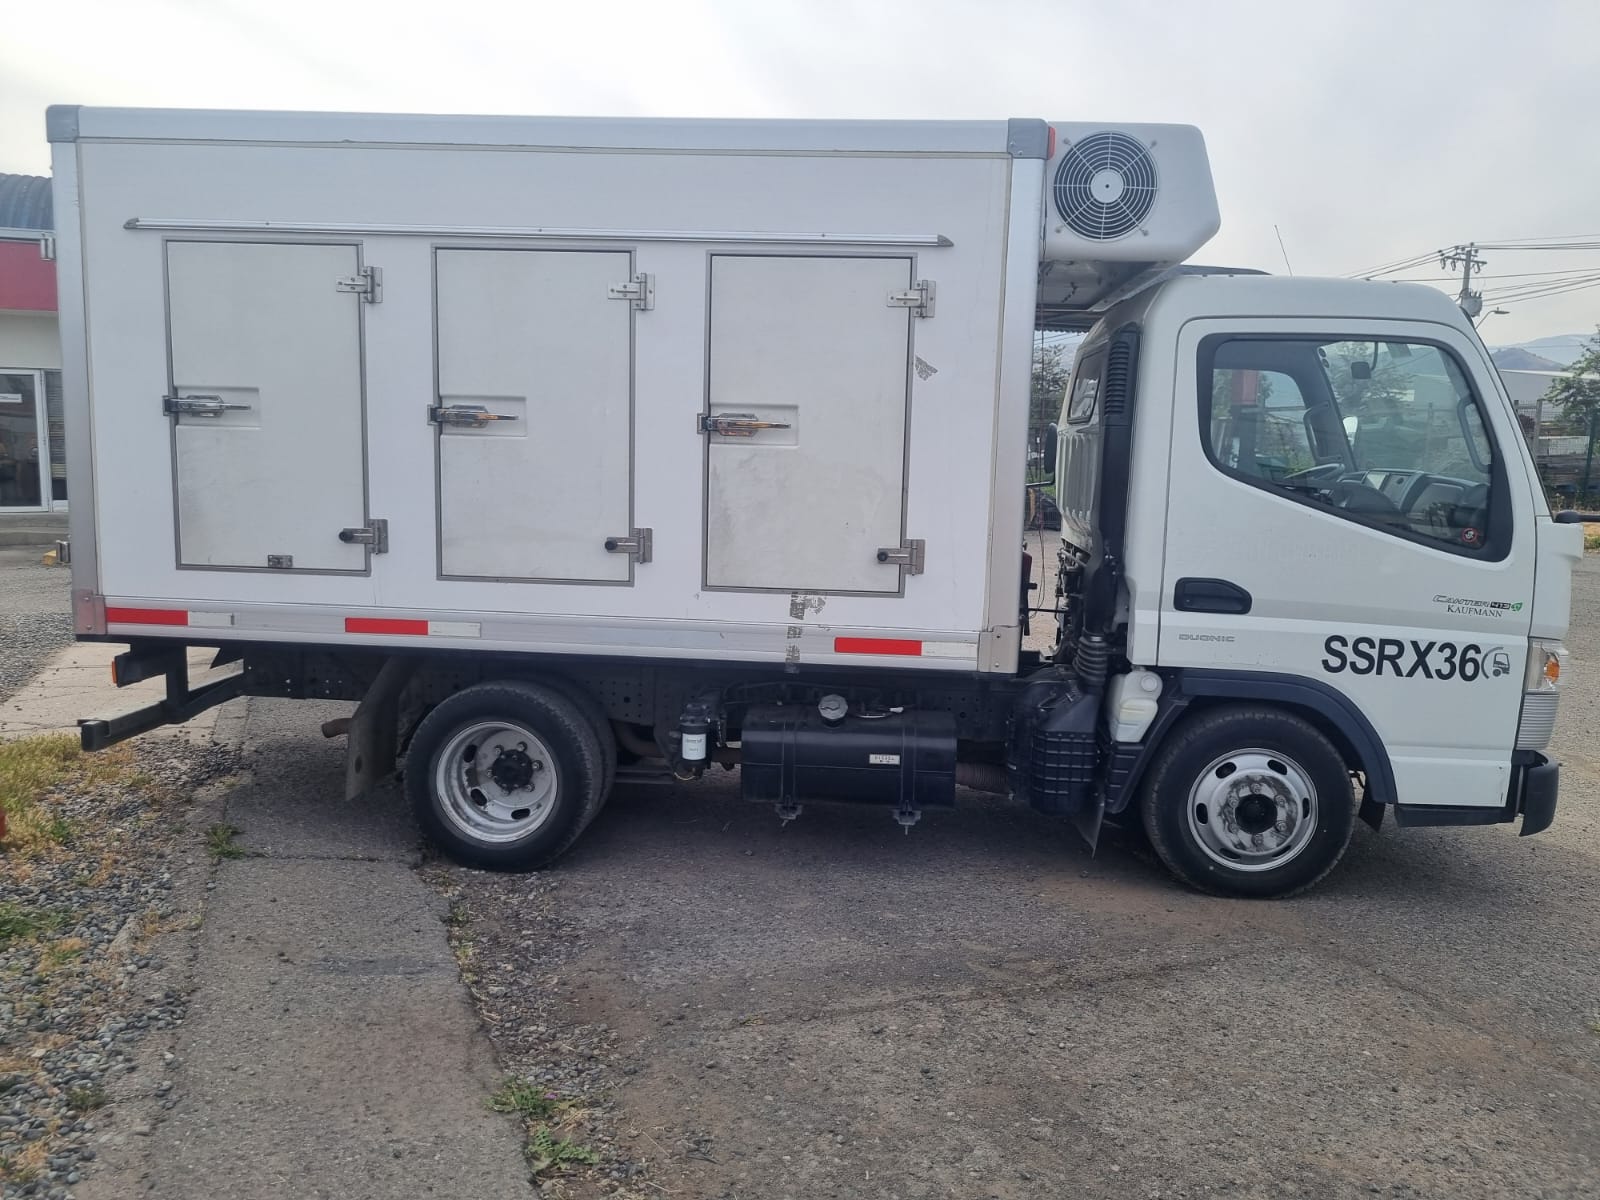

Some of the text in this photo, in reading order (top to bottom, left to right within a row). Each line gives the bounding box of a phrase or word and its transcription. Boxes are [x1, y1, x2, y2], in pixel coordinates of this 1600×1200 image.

[1447, 604, 1503, 618] KAUFMANN
[1178, 633, 1236, 643] DUONIC
[1321, 634, 1482, 682] SSRX36
